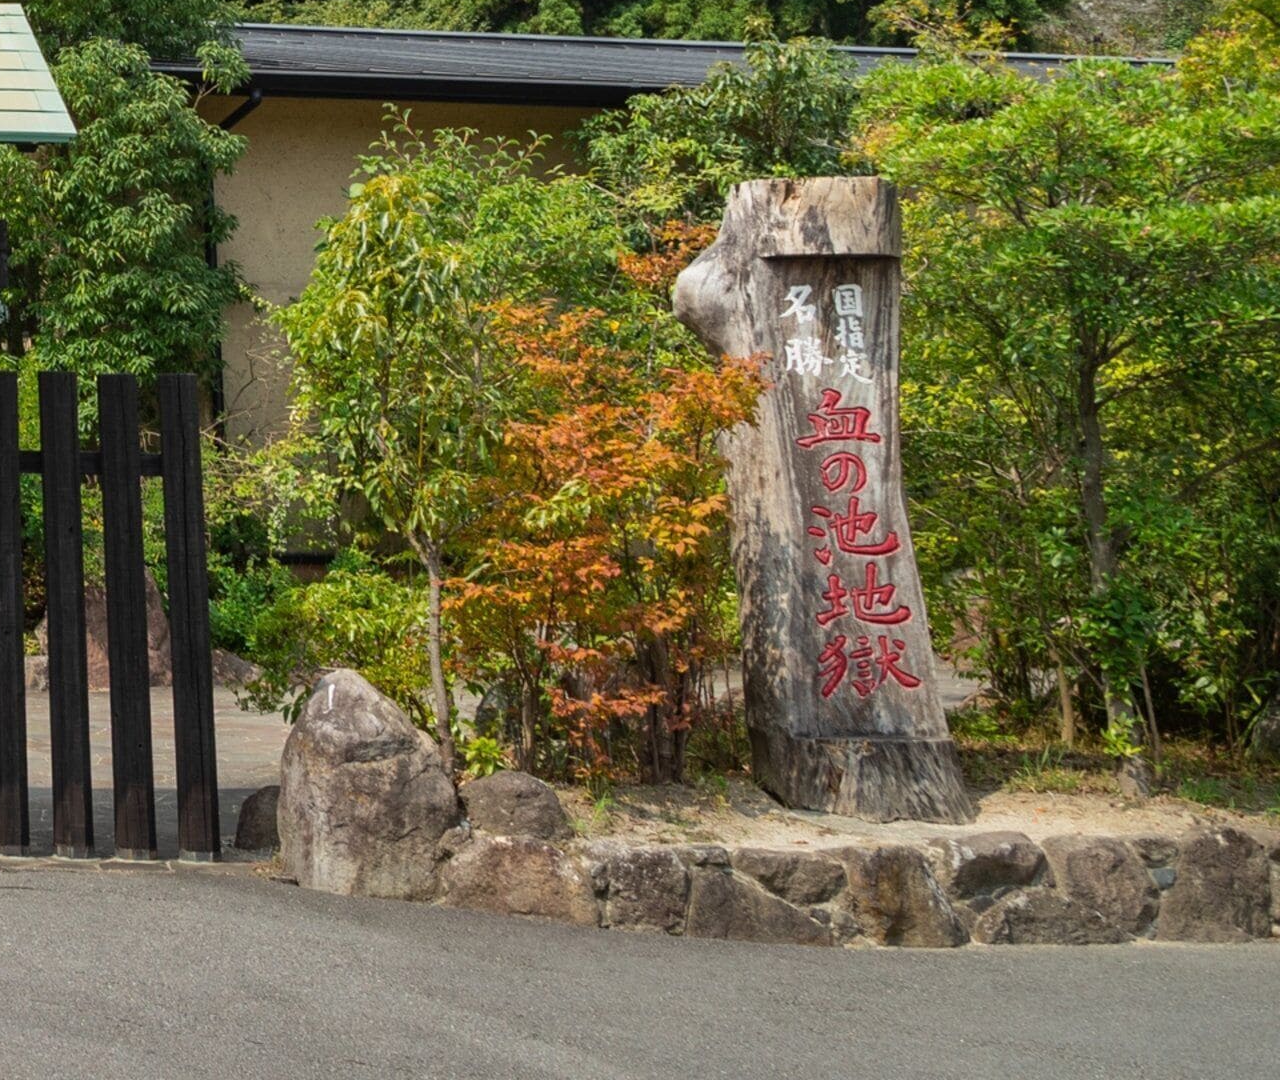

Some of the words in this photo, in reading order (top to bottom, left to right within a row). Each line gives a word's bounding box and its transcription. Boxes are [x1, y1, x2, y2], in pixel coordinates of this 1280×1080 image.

[779, 285, 834, 377] 名勝
[832, 283, 875, 385] 国指定
[796, 387, 922, 699] 血の池地獄
